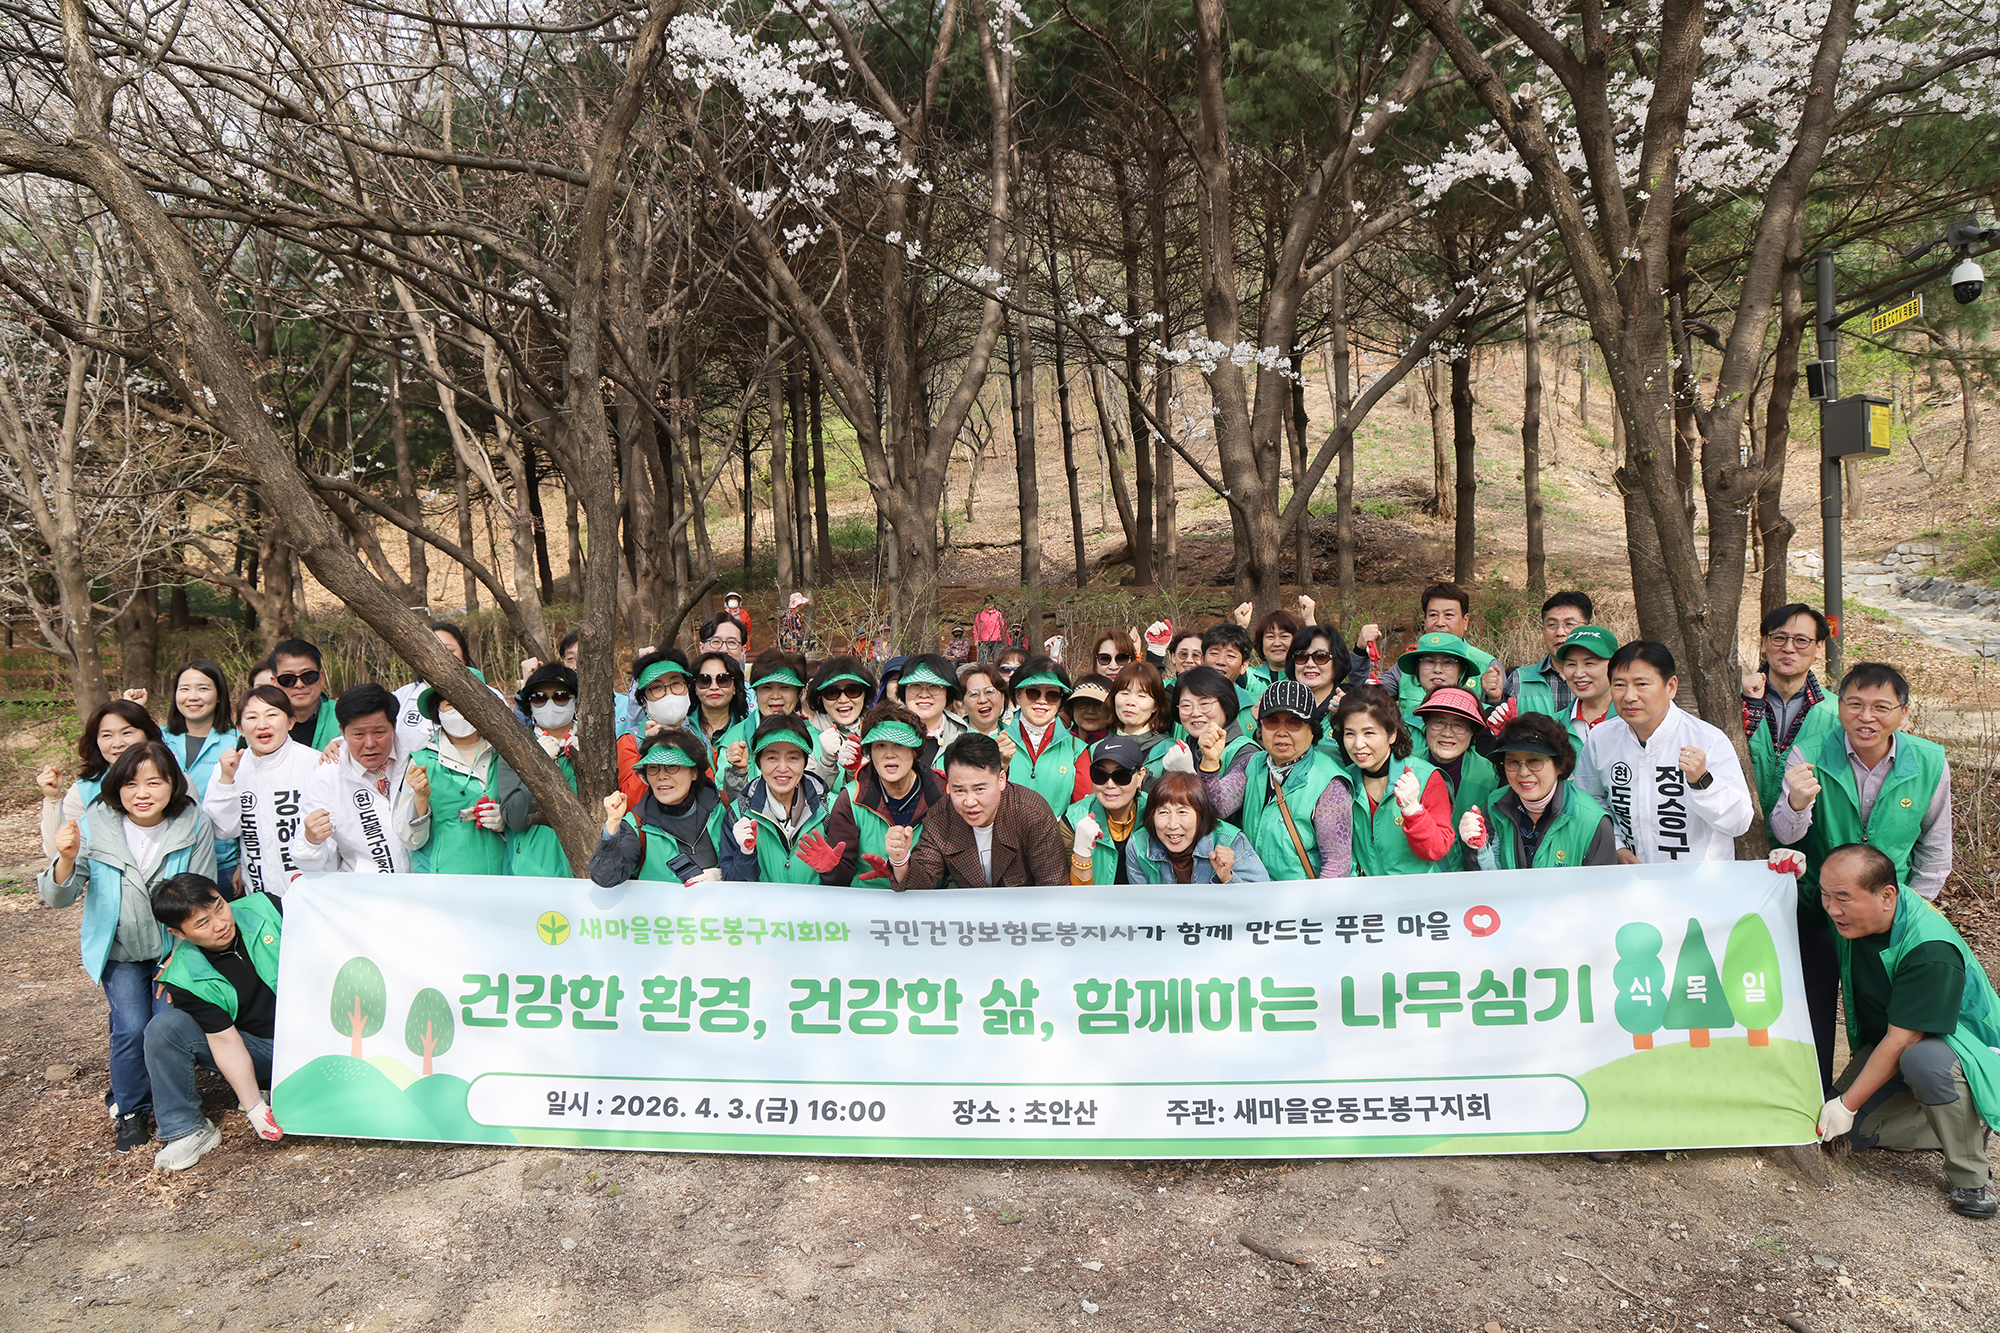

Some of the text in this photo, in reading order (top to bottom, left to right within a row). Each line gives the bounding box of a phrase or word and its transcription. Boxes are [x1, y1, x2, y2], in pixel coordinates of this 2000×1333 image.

[405, 711, 422, 726] 현
[1613, 764, 1629, 783] 현
[240, 793, 254, 810] 현
[354, 791, 372, 808] 현
[1656, 766, 1690, 860] 정승구
[578, 911, 1450, 947] 새마을운동도봉구지회와 국민건강보험도봉지사가 함께 만드는 푸른 마을
[1629, 971, 1766, 1007] 식 목 일
[460, 965, 1593, 1041] 건강한 환경, 건강한 삶, 함께하는 나무심기
[611, 1096, 685, 1117] 2026.
[695, 1098, 718, 1118] 4.
[809, 1101, 885, 1121] 16:00
[1024, 1100, 1097, 1125] 초안산
[1167, 1094, 1490, 1125] 주관: 새마을운동도봉구지회
